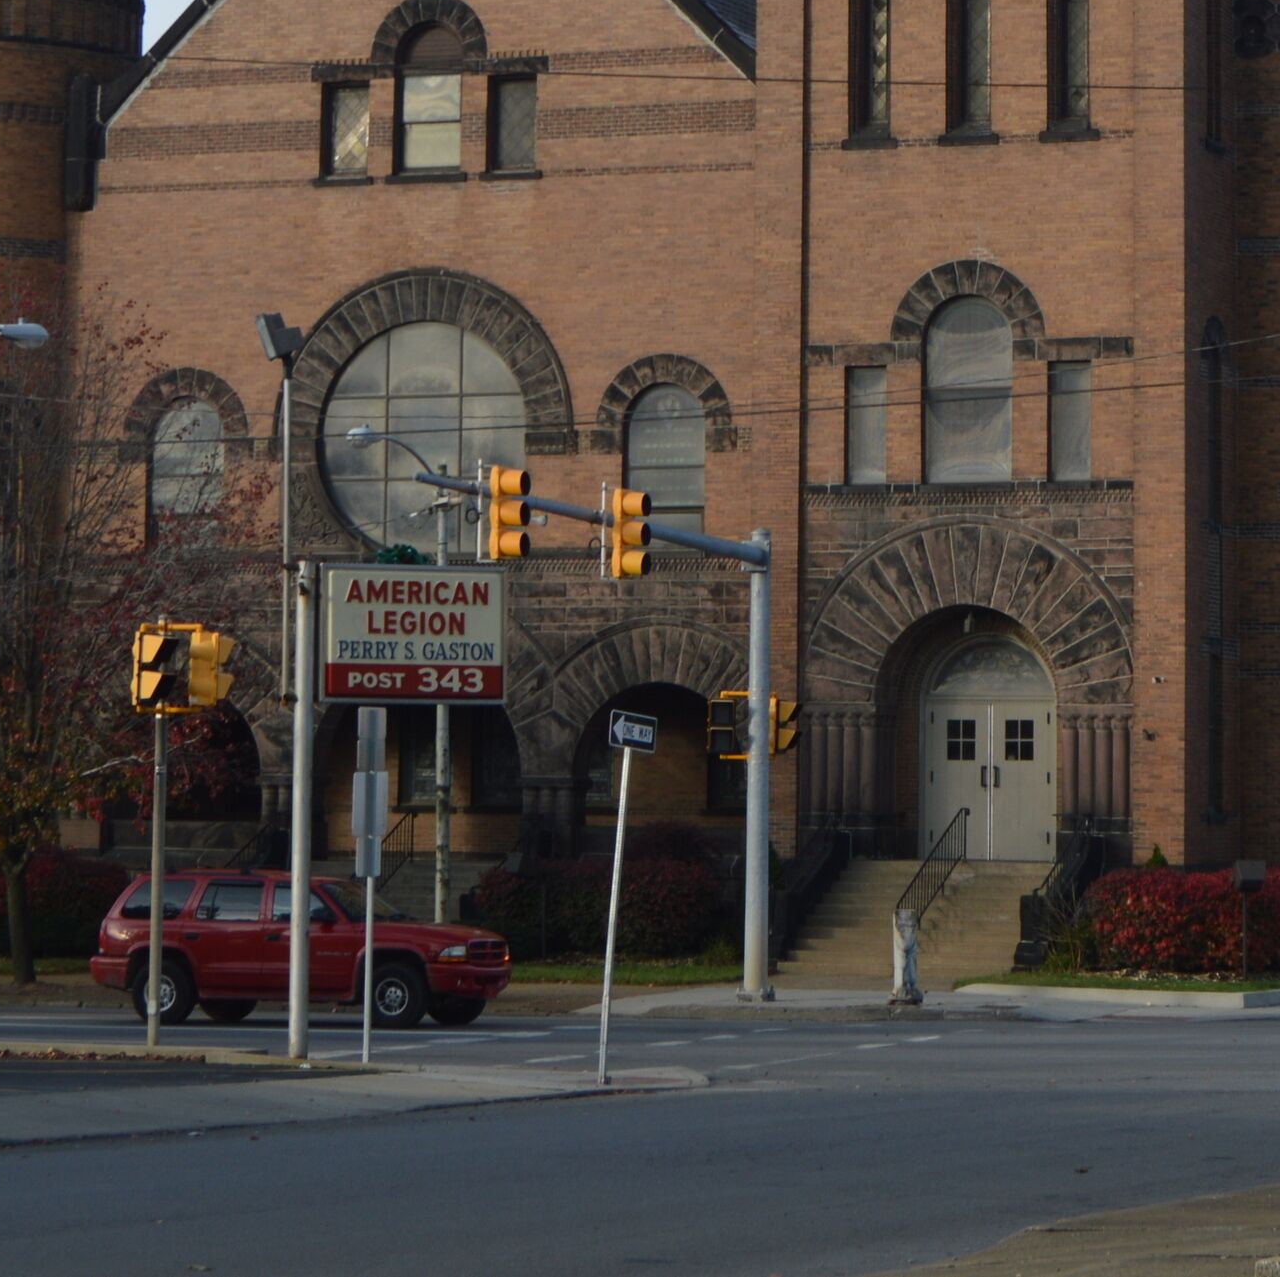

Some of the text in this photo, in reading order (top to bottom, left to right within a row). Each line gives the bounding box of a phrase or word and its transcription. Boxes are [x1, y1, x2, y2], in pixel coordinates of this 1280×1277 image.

[345, 579, 490, 606] AMERICAN
[367, 610, 466, 636] LEGION
[337, 639, 494, 662] PERRY S. GASTON
[348, 667, 484, 694] POST 343
[623, 723, 652, 741] ONE WAY
